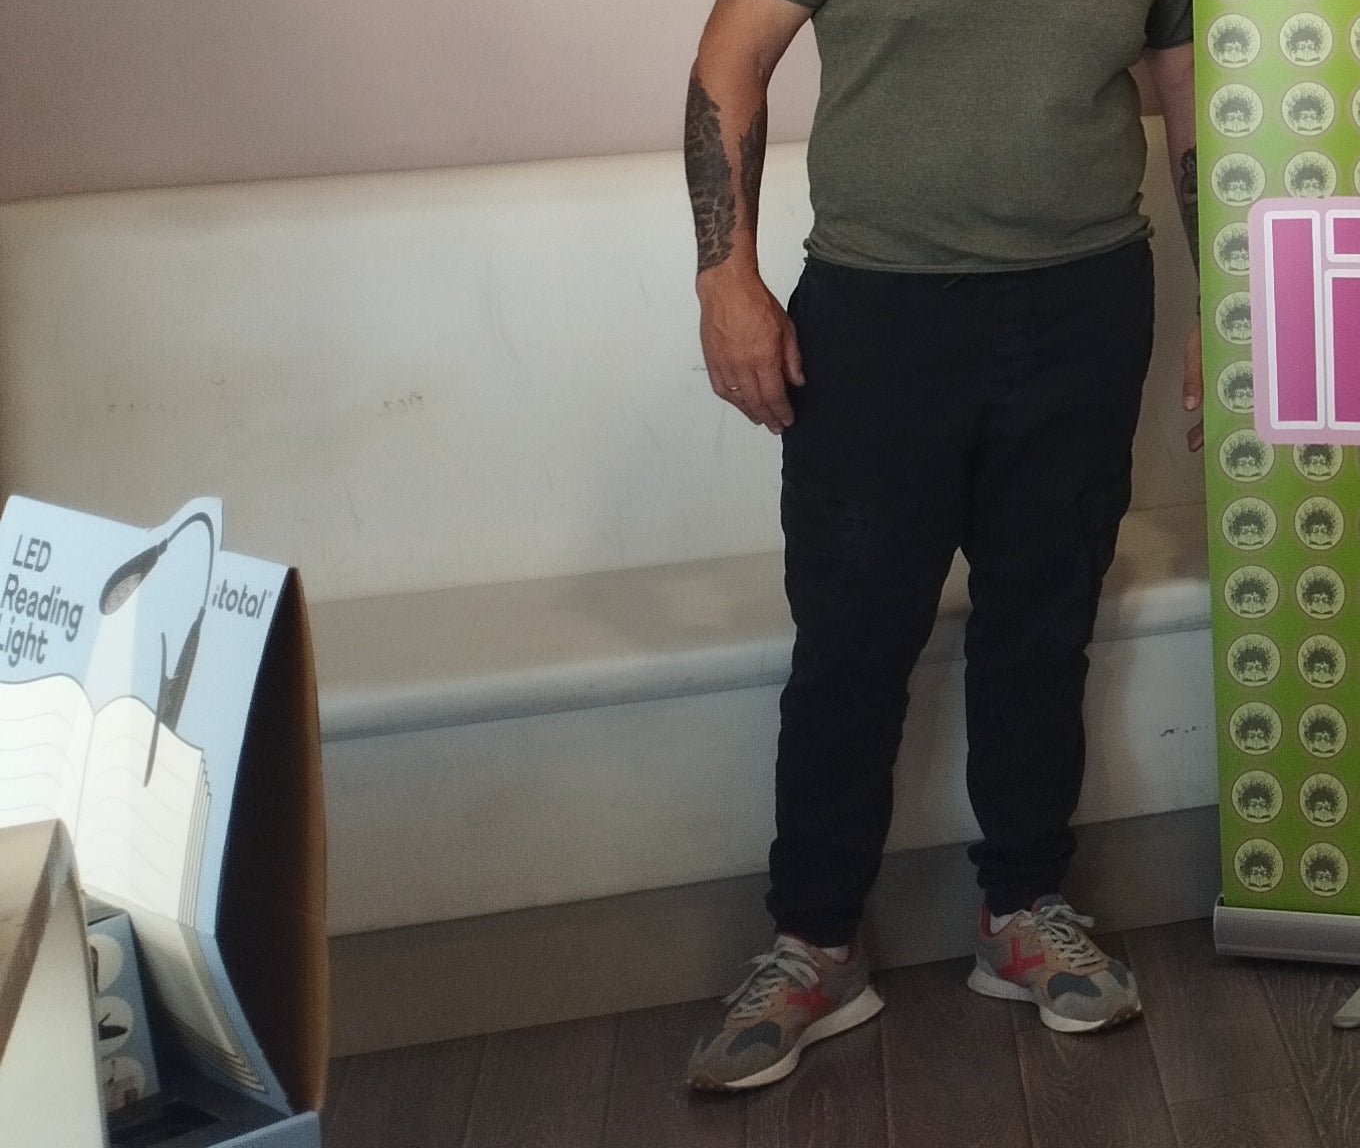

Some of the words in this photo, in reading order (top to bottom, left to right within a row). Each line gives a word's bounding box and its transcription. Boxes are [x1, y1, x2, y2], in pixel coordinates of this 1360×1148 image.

[12, 534, 51, 572] LED
[1, 573, 84, 642] Reading
[211, 579, 268, 619] itotal
